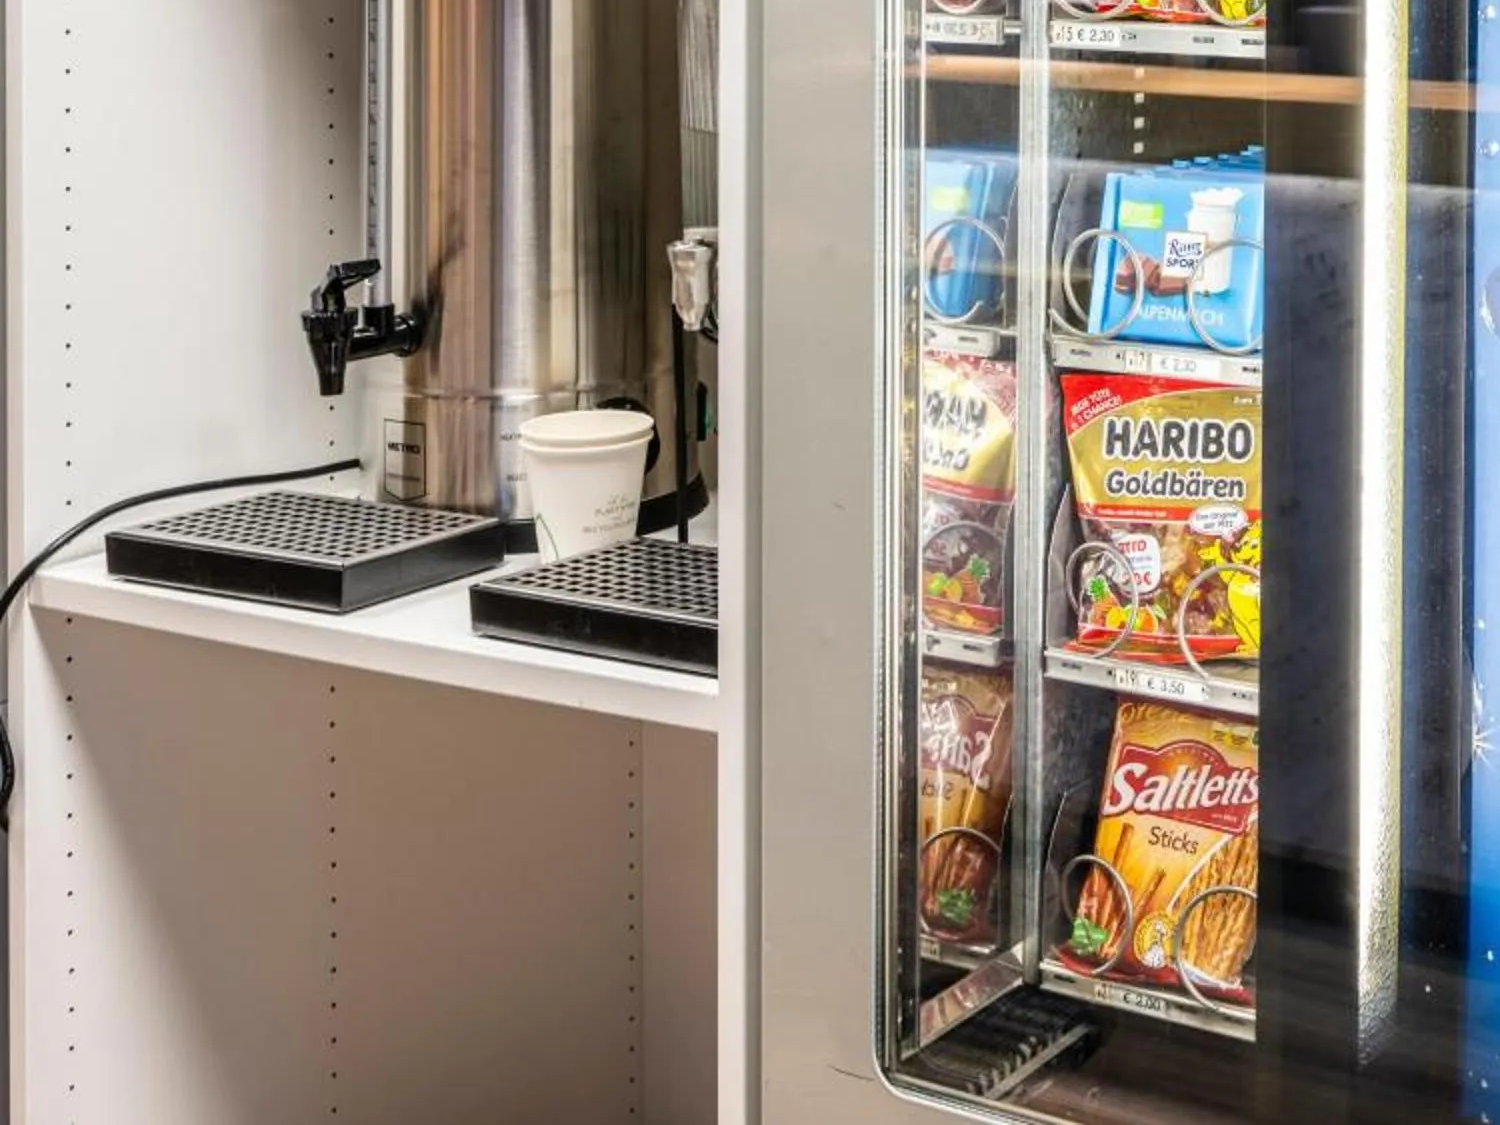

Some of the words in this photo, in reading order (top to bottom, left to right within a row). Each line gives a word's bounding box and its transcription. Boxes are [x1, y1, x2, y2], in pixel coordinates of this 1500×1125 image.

[1105, 418, 1255, 461] HARIBO
[1106, 471, 1246, 499] Goldbären
[1103, 761, 1258, 816] Saltletts
[1148, 826, 1200, 855] Sticks
